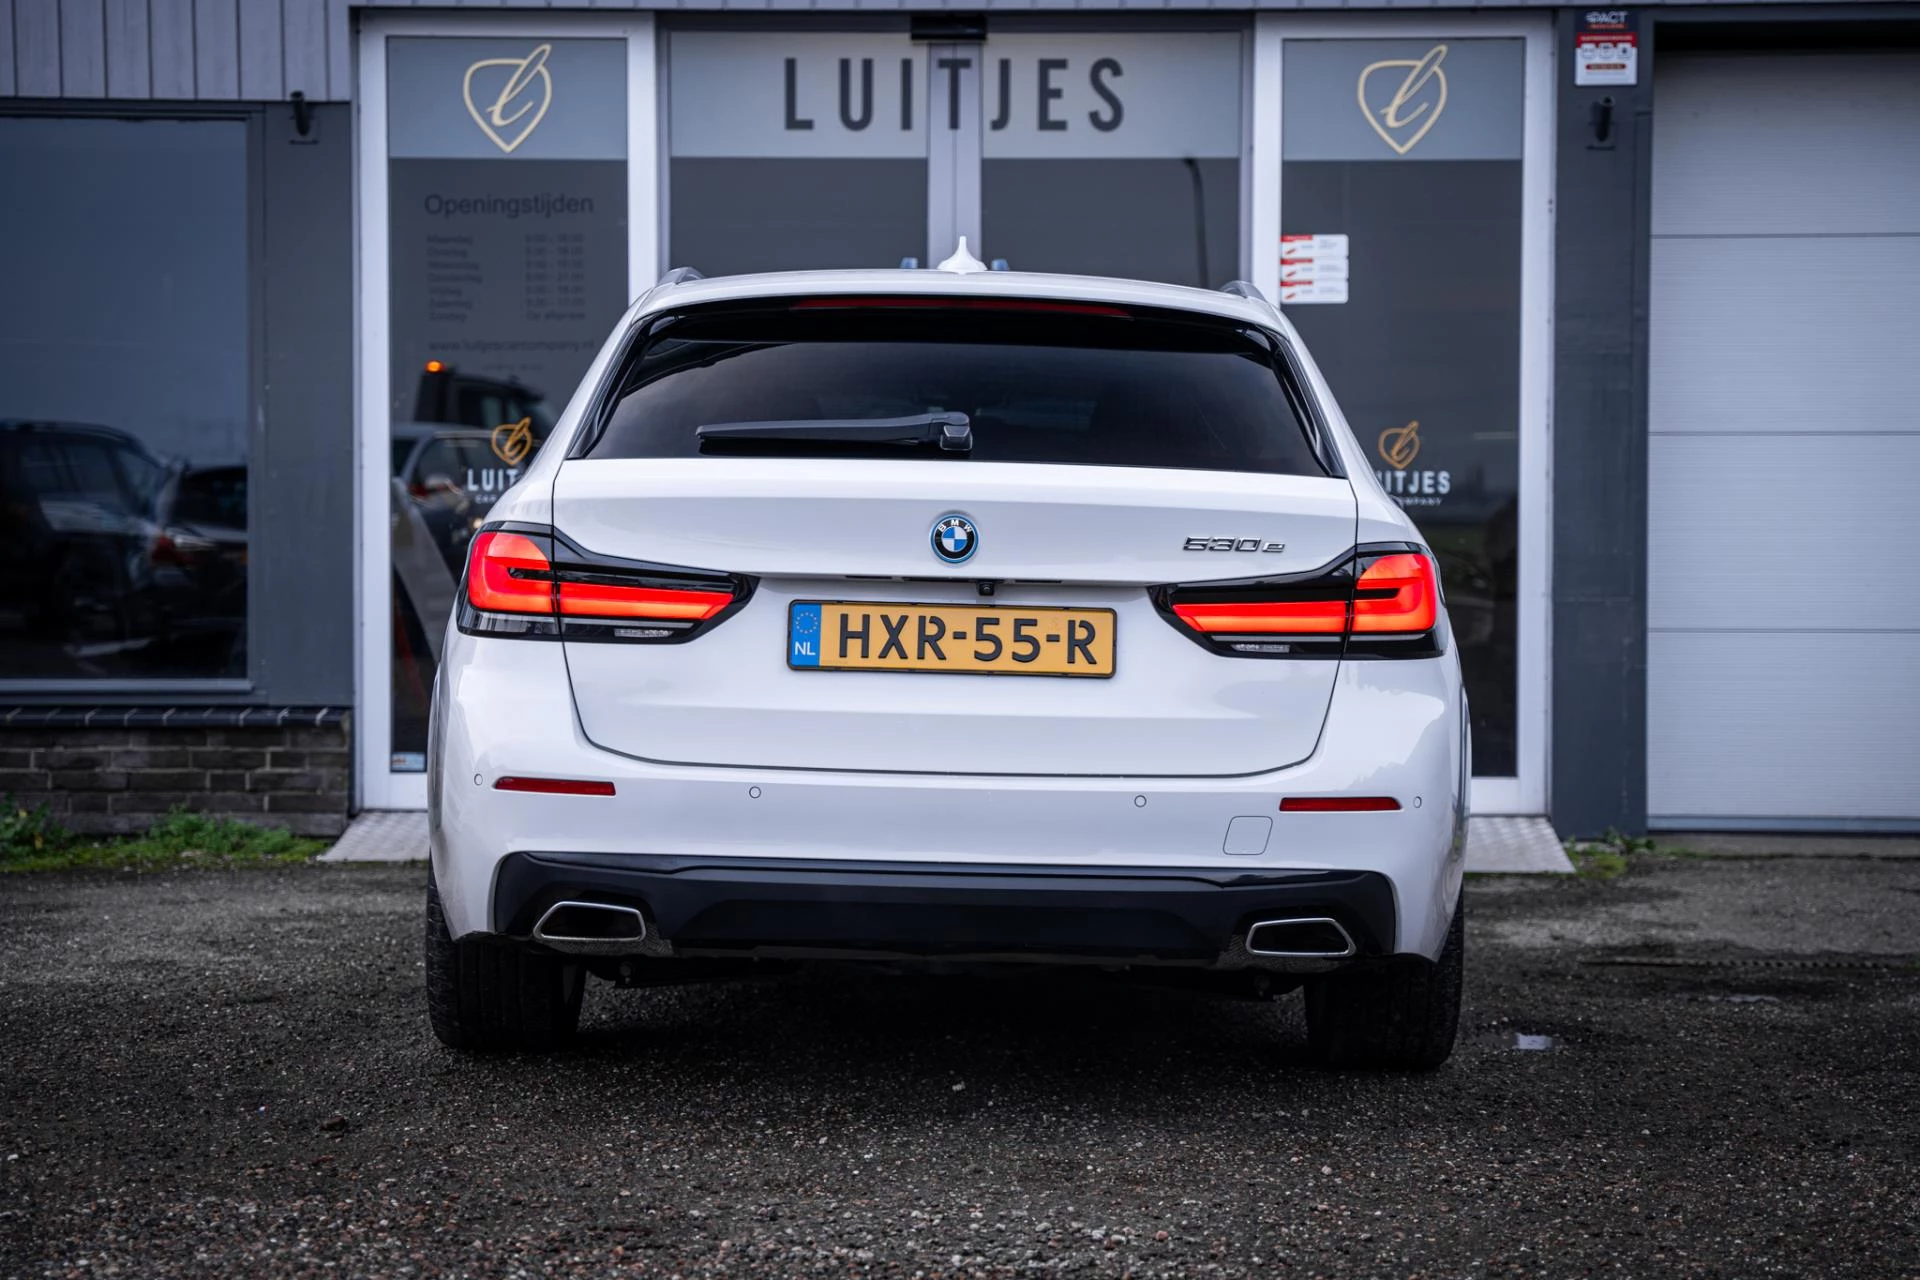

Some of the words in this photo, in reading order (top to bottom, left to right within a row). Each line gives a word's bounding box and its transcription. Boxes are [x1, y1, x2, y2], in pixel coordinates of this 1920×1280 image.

[784, 57, 1124, 133] LUITJES
[424, 193, 594, 219] Openingstijden
[939, 519, 973, 533] BMW
[1183, 536, 1285, 553] 530e
[794, 641, 816, 656] NL
[839, 613, 1098, 665] HXR-55-R
